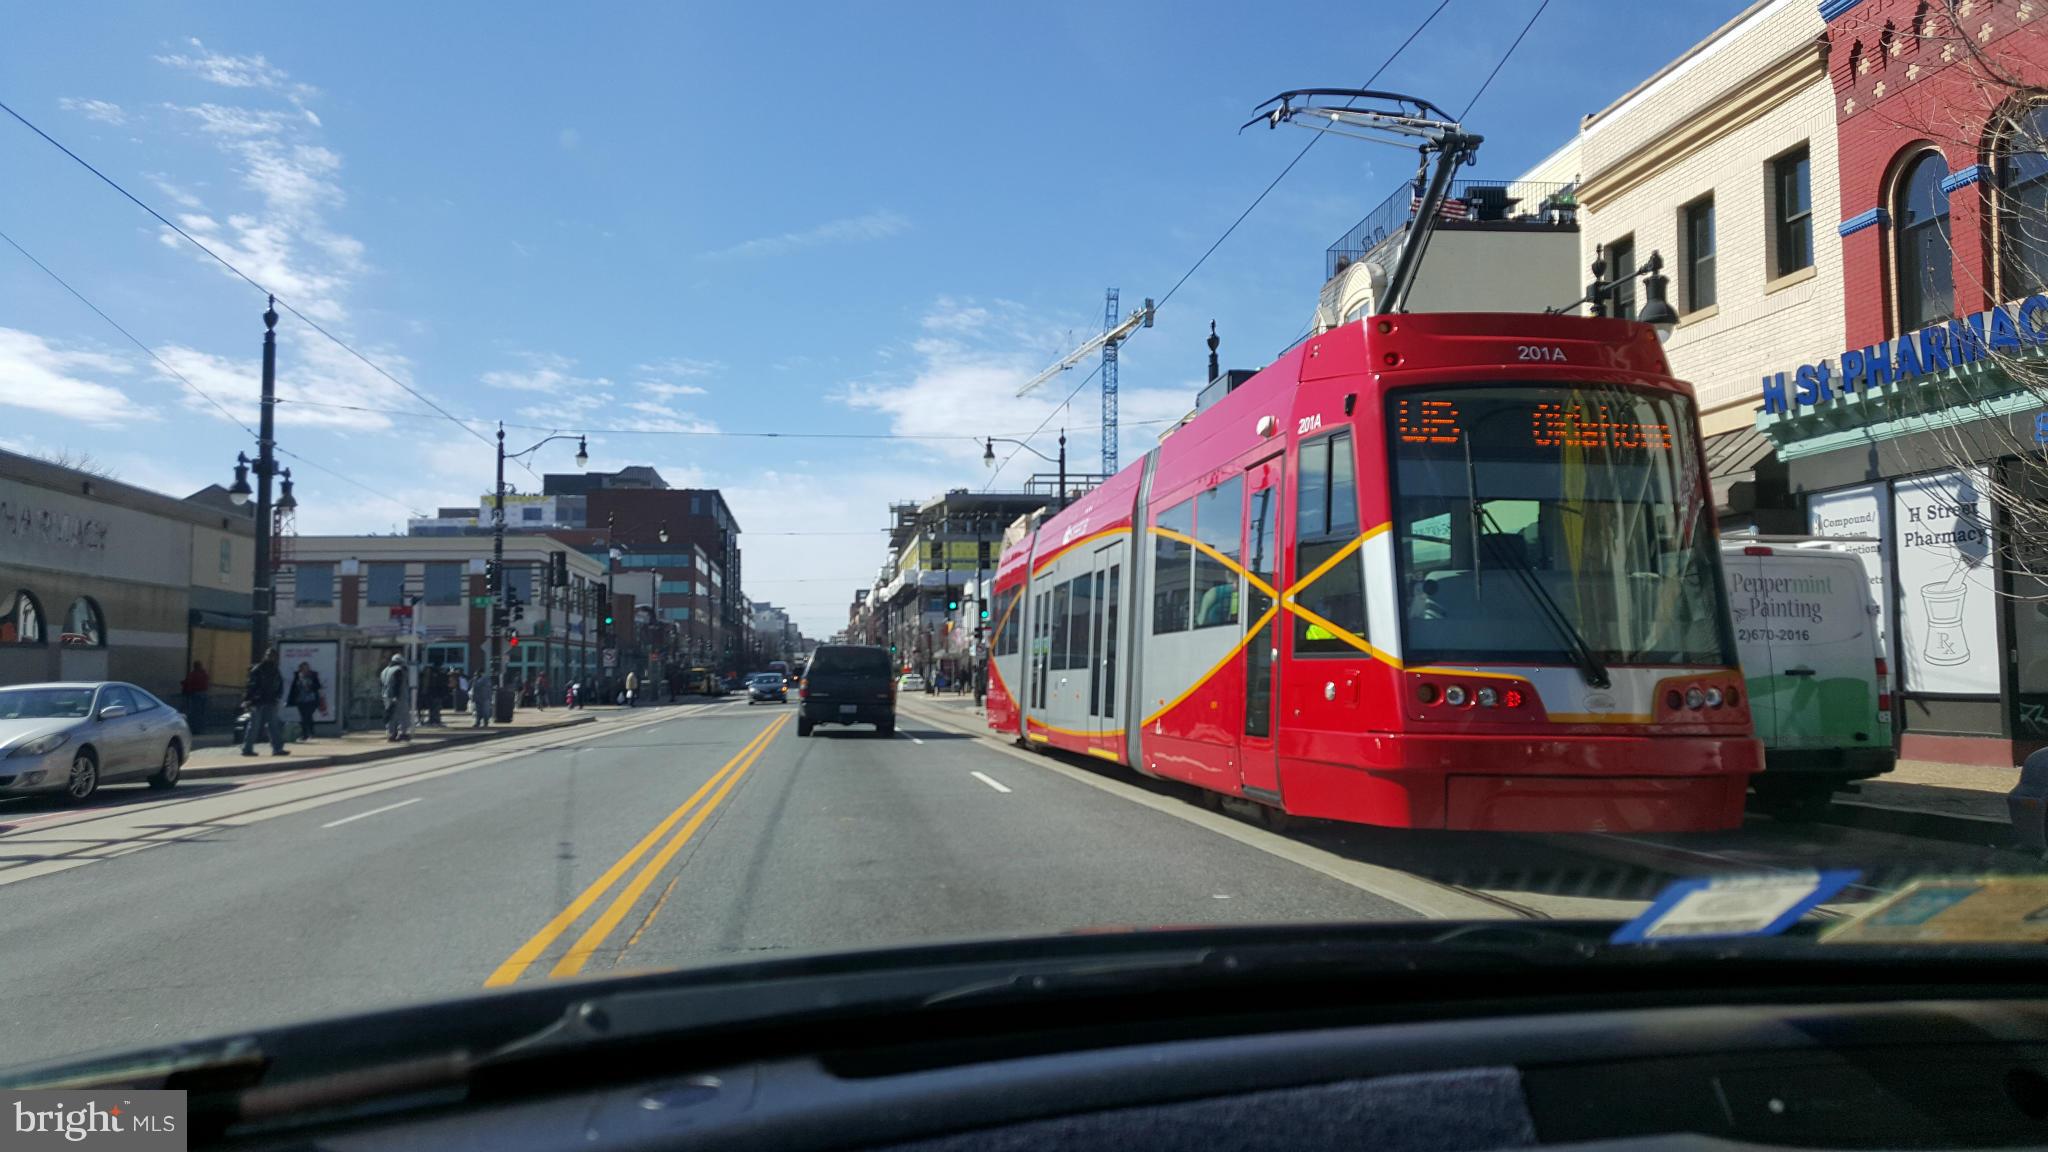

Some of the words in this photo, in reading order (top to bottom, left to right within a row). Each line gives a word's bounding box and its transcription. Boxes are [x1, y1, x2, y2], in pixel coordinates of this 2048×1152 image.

[1518, 346, 1567, 361] 201A
[1762, 371, 1788, 415] H
[1796, 360, 1834, 406] St
[1297, 413, 1322, 435] 201A
[1909, 507, 1922, 523] H
[1927, 502, 1979, 521] Street
[1904, 526, 1986, 548] Pharmacy
[1732, 573, 1833, 598] Peppermint
[1750, 598, 1823, 624] Painting
